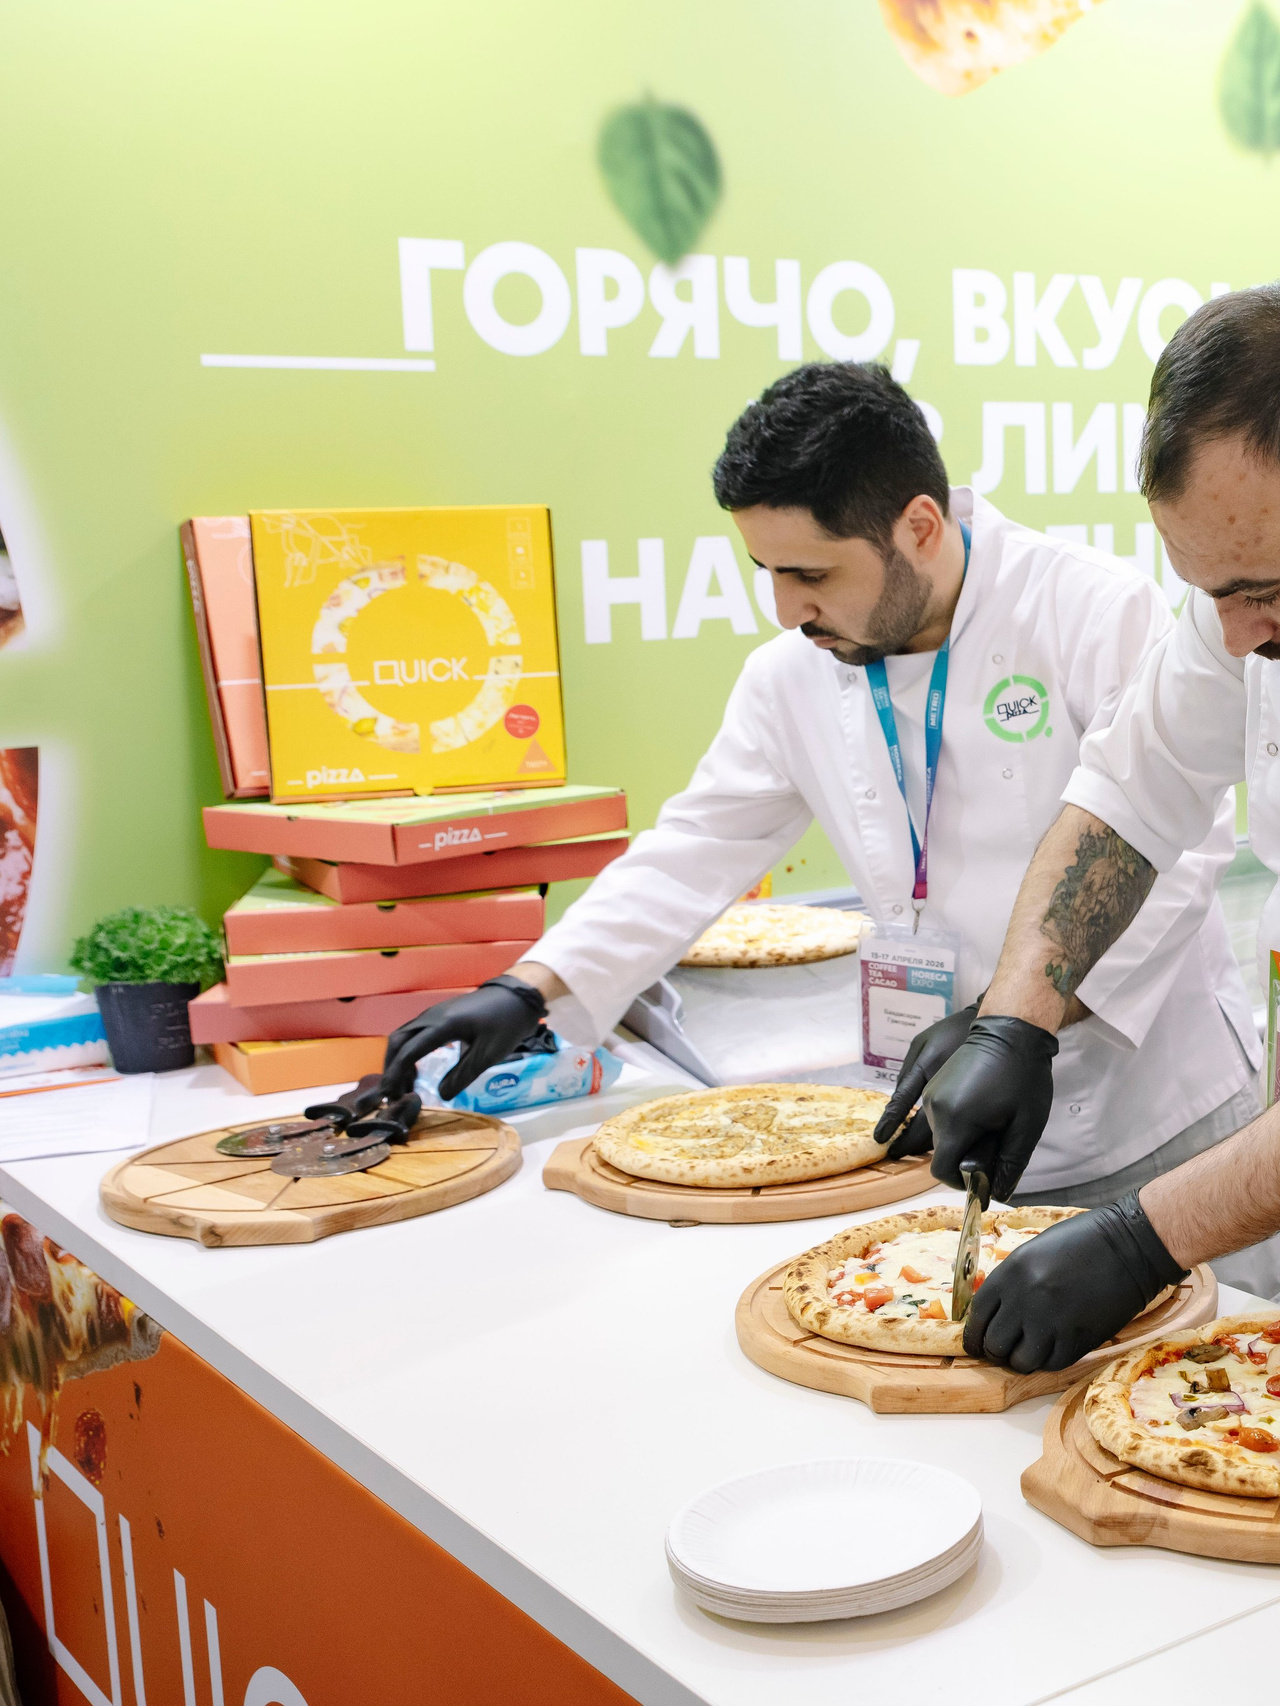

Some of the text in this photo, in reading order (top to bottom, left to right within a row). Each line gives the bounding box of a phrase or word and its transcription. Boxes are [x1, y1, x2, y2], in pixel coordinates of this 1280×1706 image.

[398, 237, 921, 383] ГОРЯЧО,
[373, 657, 470, 686] QUICK
[930, 692, 940, 727] METRO
[996, 695, 1038, 715] QUICK
[871, 951, 890, 960] 15-17
[891, 955, 924, 965] АПРЕЛЯ
[868, 962, 898, 973] COFFEE
[868, 969, 883, 978] TEA
[868, 976, 898, 988] CACAO
[911, 970, 948, 982] HORECA
[911, 978, 934, 988] EXPO
[488, 1078, 517, 1091] AURA
